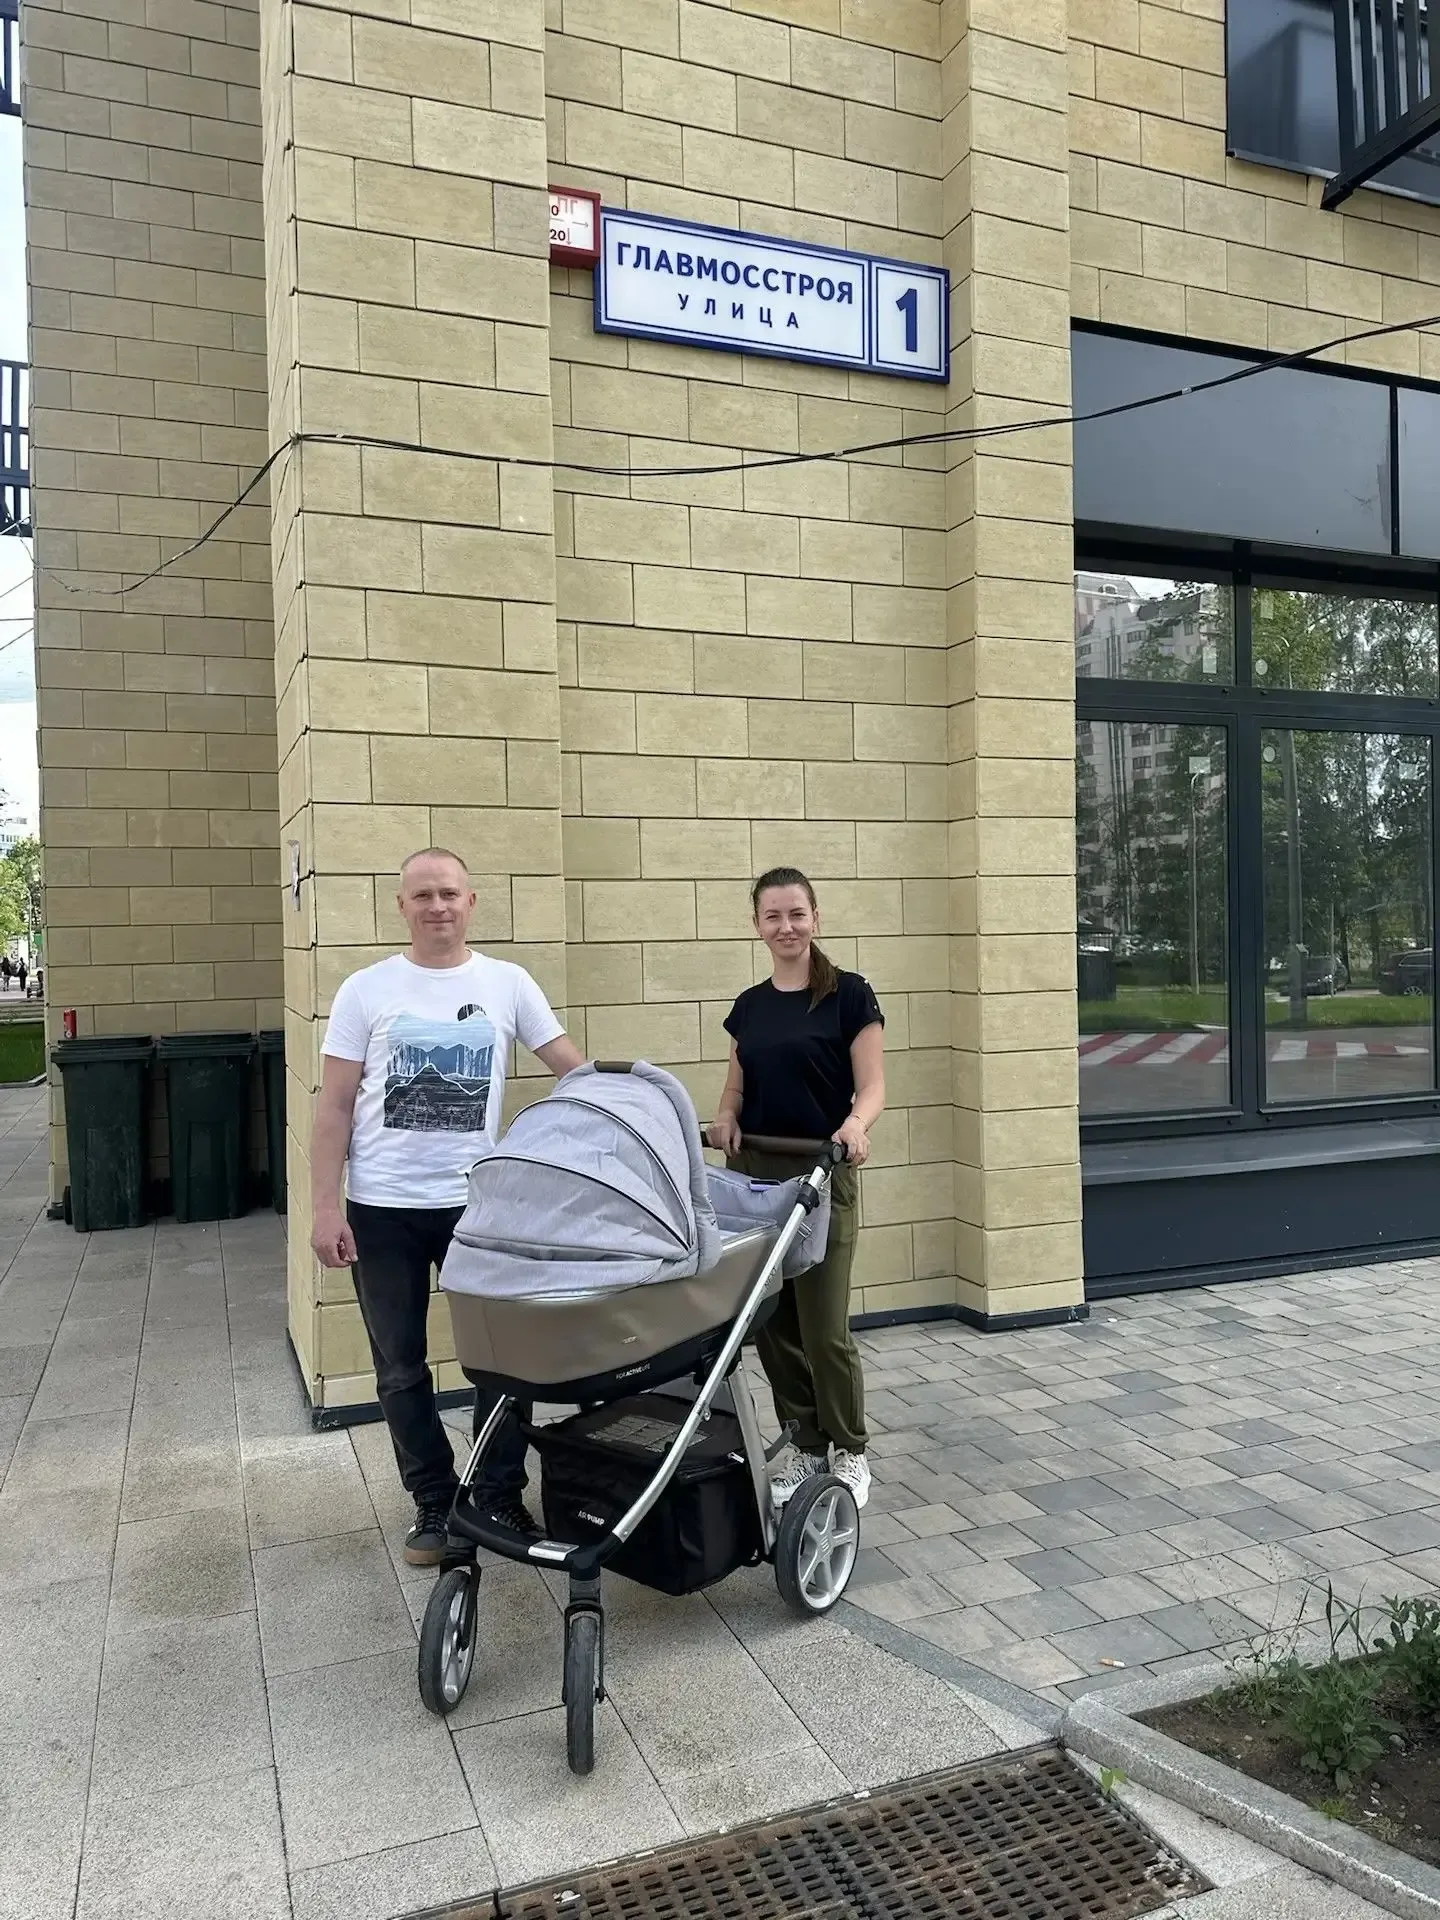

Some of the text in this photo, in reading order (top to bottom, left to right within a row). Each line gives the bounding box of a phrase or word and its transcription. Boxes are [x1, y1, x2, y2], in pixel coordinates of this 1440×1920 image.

[617, 241, 854, 304] ГЛАВМОССТРОЯ
[677, 293, 799, 329] УЛИЦА
[896, 287, 918, 353] 1
